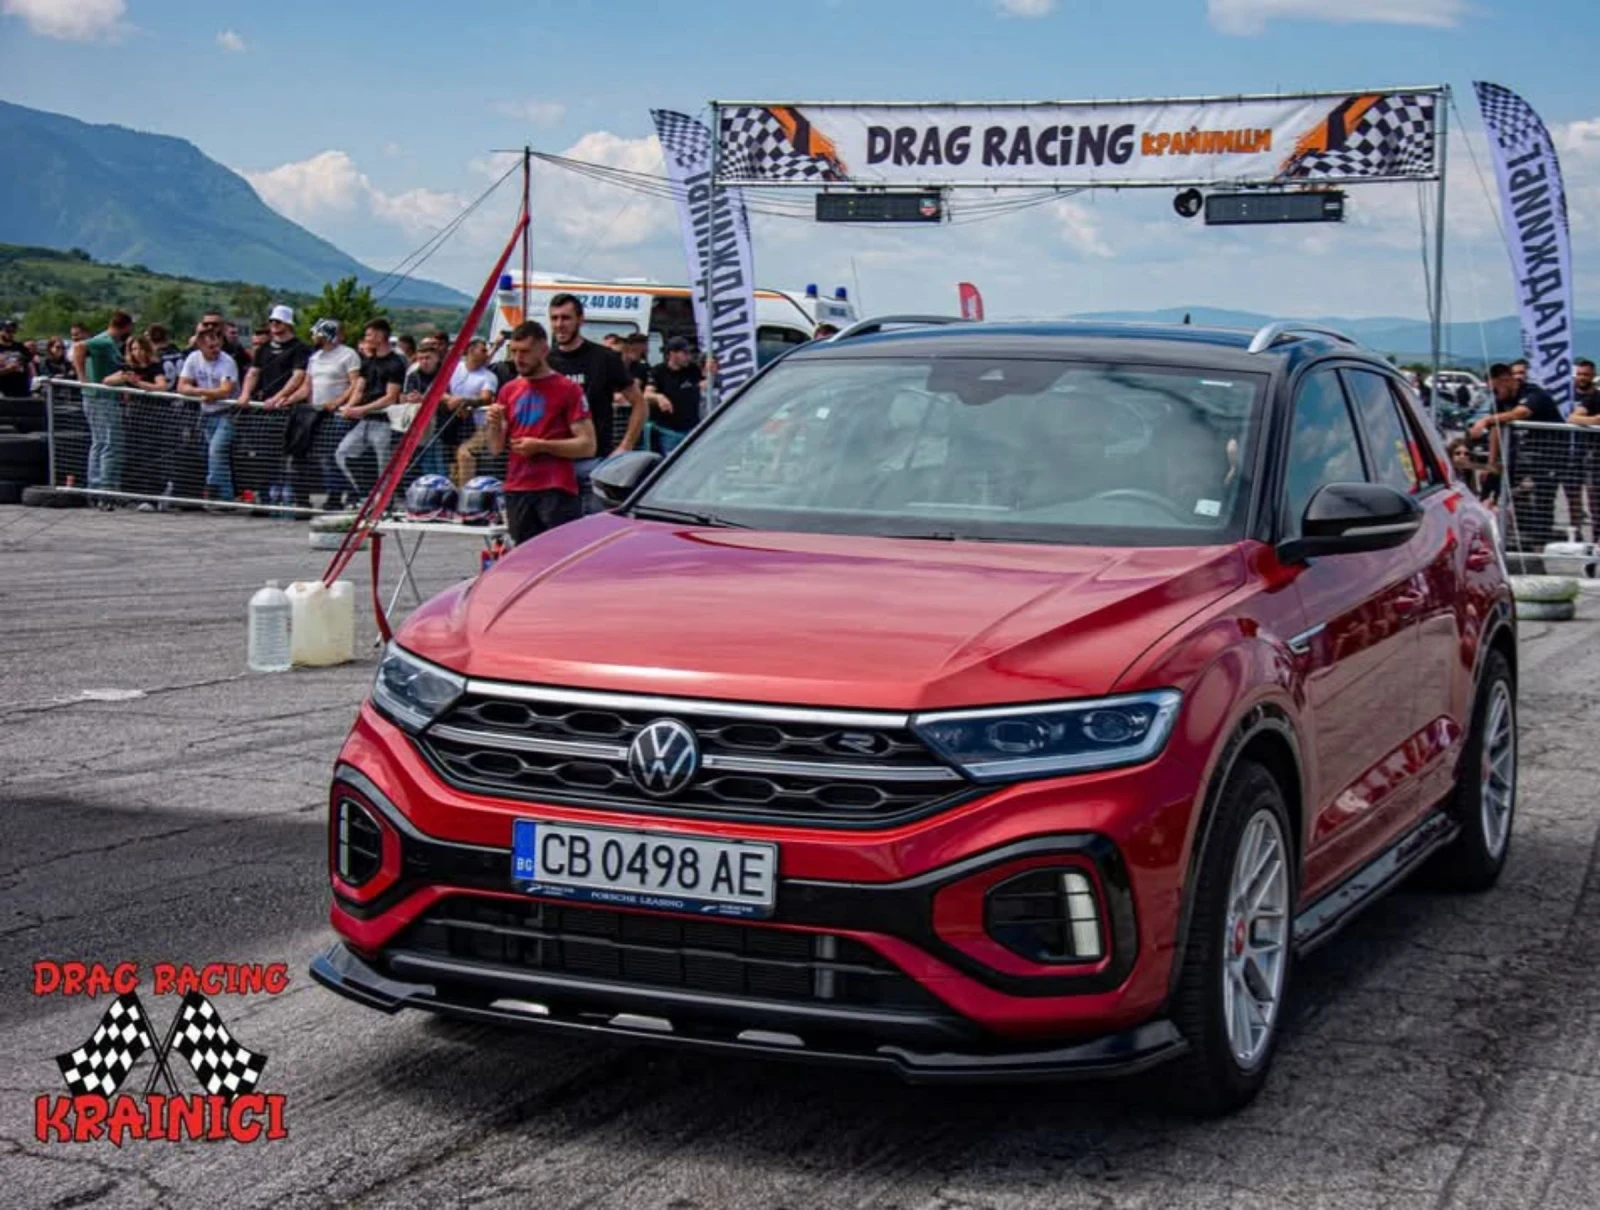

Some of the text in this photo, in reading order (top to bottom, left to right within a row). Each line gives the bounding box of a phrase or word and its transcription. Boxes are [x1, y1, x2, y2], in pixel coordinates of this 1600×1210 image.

[866, 125, 972, 166] DRAG
[516, 857, 533, 871] BG
[541, 833, 765, 896] CB 0498 AE
